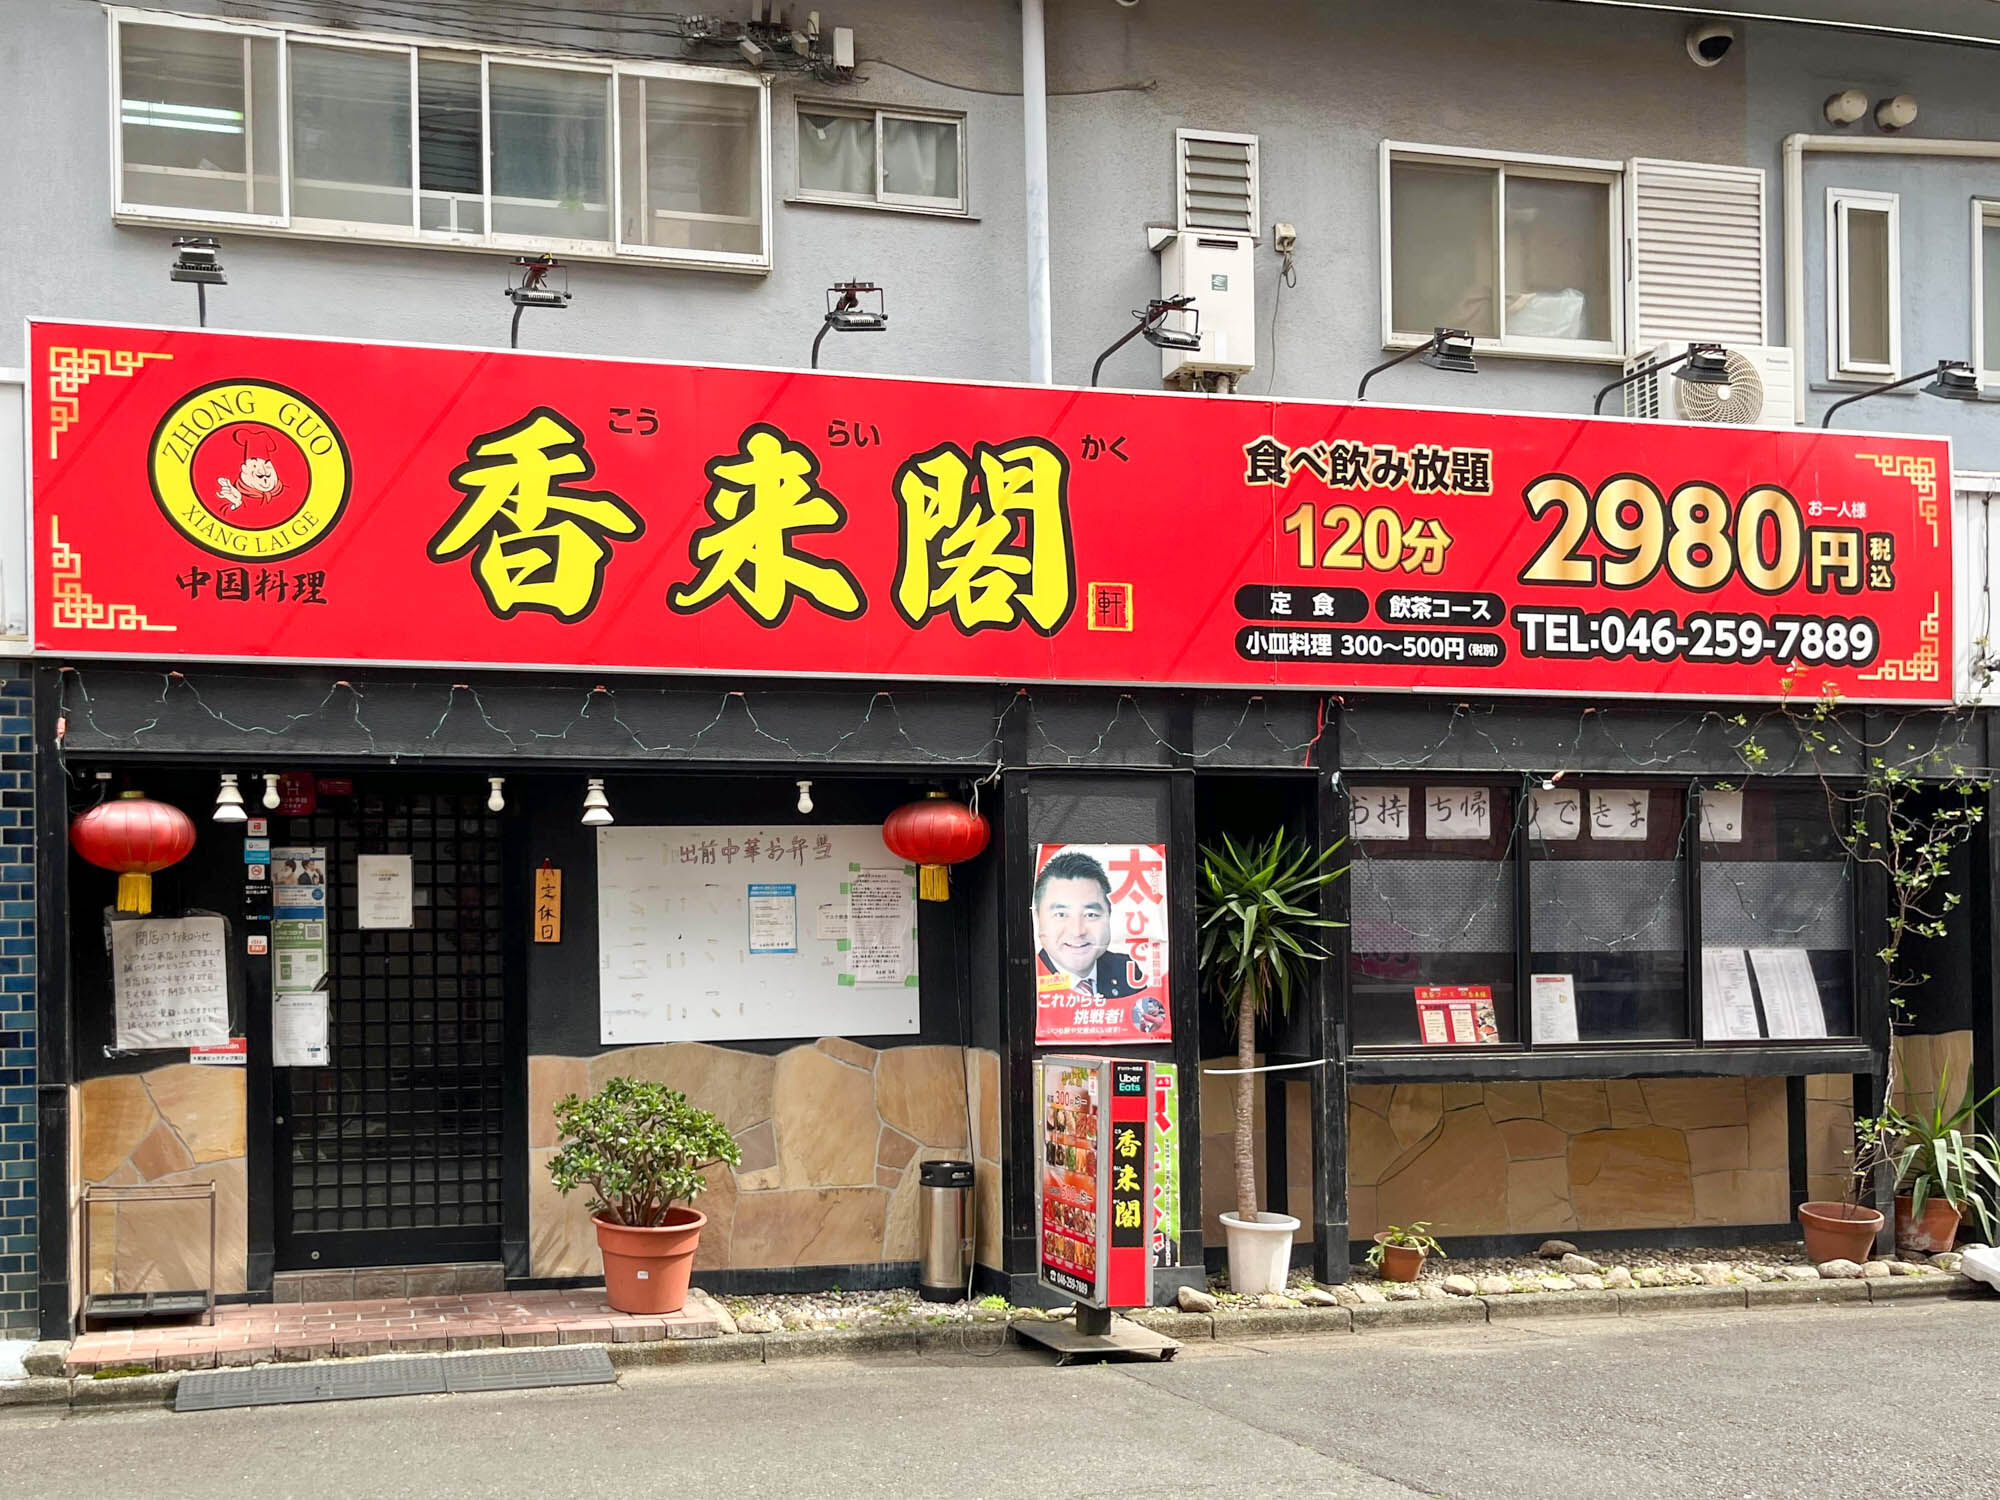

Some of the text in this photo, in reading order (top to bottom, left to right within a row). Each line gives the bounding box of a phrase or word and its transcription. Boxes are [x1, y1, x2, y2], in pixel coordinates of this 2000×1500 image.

[162, 390, 333, 464] ZHONG GUO
[608, 407, 659, 436] こう
[826, 420, 880, 447] らい
[1080, 434, 1130, 461] かく
[1243, 437, 1493, 496] 食べ飲み放題
[182, 504, 319, 553] XIANG LAI GE
[430, 408, 1072, 633] 香来閣
[1808, 500, 1867, 519] お一人様
[1284, 503, 1454, 574] 120分
[1869, 536, 1893, 589] 税込
[176, 566, 328, 604] 中国料理
[1389, 595, 1492, 621] 飲茶コース
[1246, 631, 1333, 657] 小皿料理
[1517, 612, 1874, 661] TEL:046-259-7889
[538, 884, 558, 940] 定休日
[1038, 993, 1106, 1008] これからも
[1119, 1073, 1141, 1083] Uber
[1119, 1083, 1141, 1091] Eats
[1114, 1129, 1142, 1228] 香来閣
